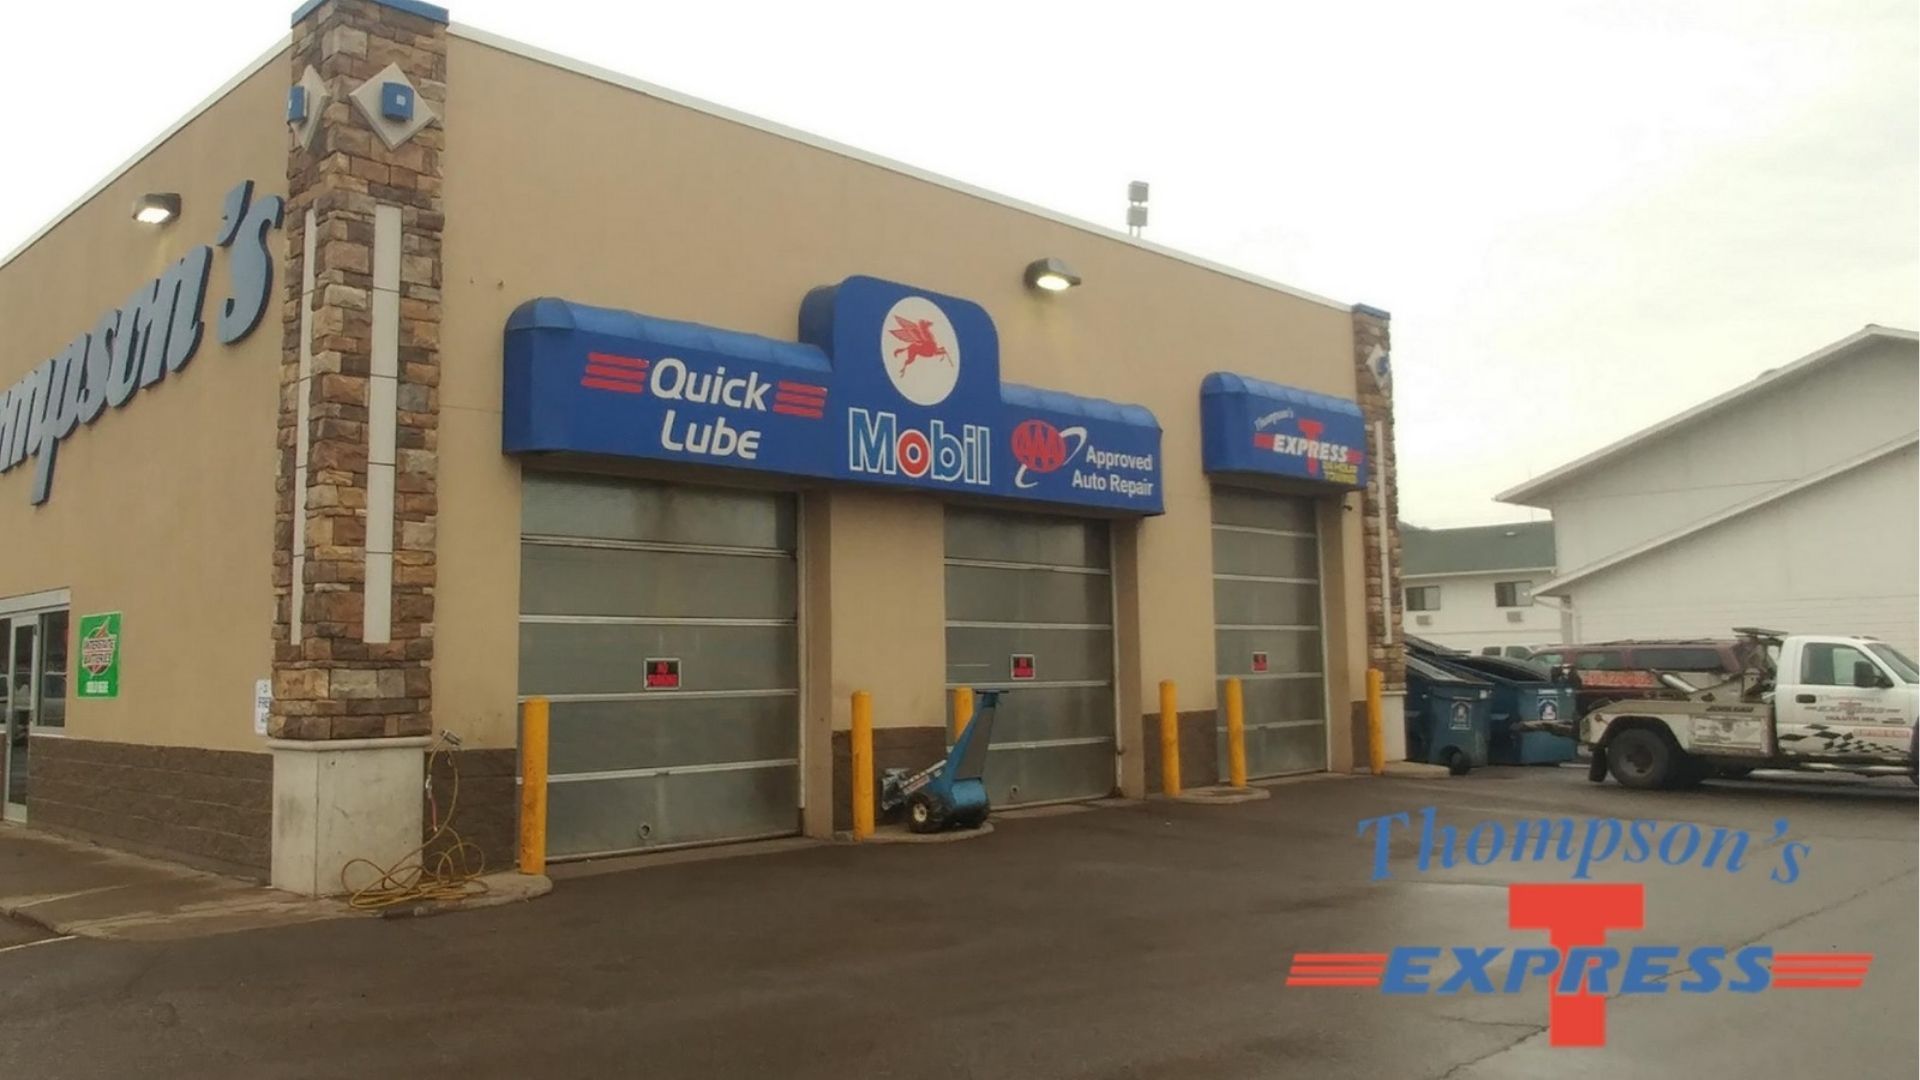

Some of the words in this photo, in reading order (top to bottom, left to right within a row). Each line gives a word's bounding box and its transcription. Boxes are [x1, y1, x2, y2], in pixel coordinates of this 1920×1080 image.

[650, 358, 771, 412] Quick
[661, 409, 762, 459] Lube
[848, 407, 991, 486] Mobil
[1273, 434, 1349, 463] EXPRESS
[1086, 445, 1153, 472] Approved
[1072, 469, 1107, 491] Auto
[1110, 473, 1154, 498] Repair
